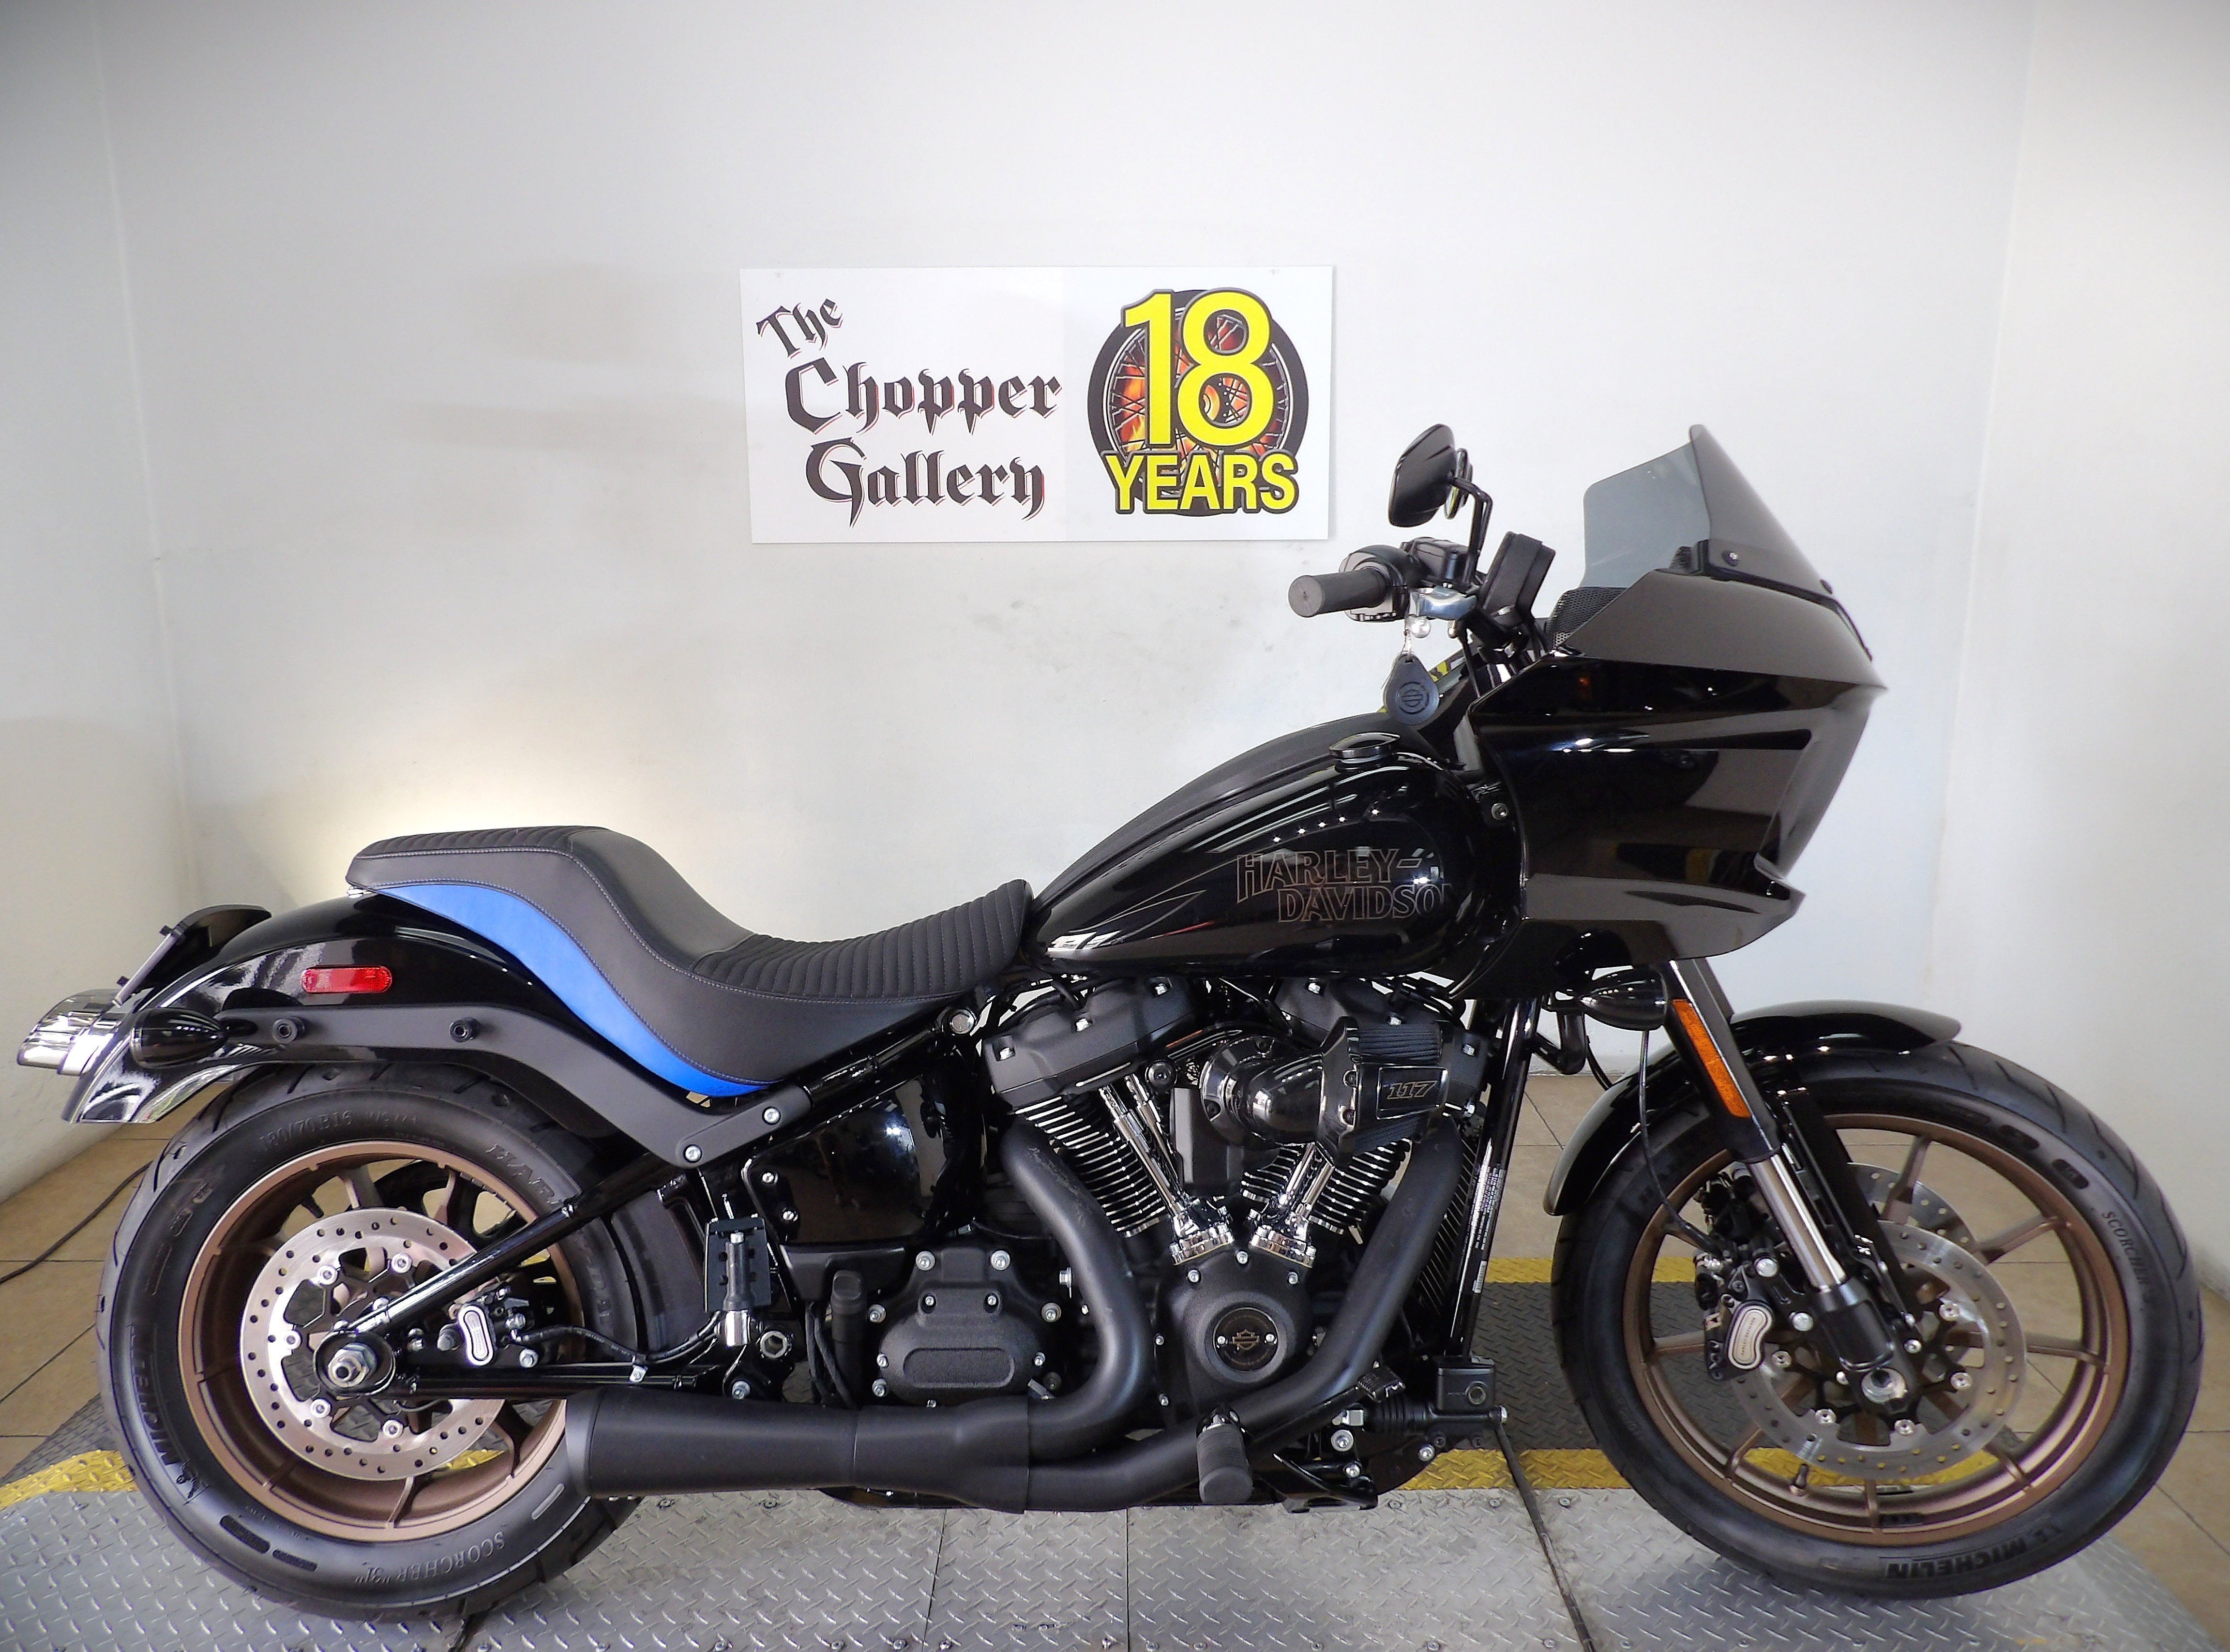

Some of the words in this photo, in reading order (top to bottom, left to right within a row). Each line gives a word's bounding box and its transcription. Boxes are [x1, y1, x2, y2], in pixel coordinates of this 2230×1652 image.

[756, 297, 844, 358] The
[785, 356, 1062, 436] Chopper
[1120, 286, 1275, 448] 18
[805, 436, 1044, 528] Gallery
[1101, 450, 1299, 514] YEARS
[1278, 883, 1451, 923] DAVIDSO
[1387, 1081, 1437, 1100] 117
[396, 1531, 505, 1582] SCORCHER
[1885, 1536, 2026, 1578] MICHELIN
